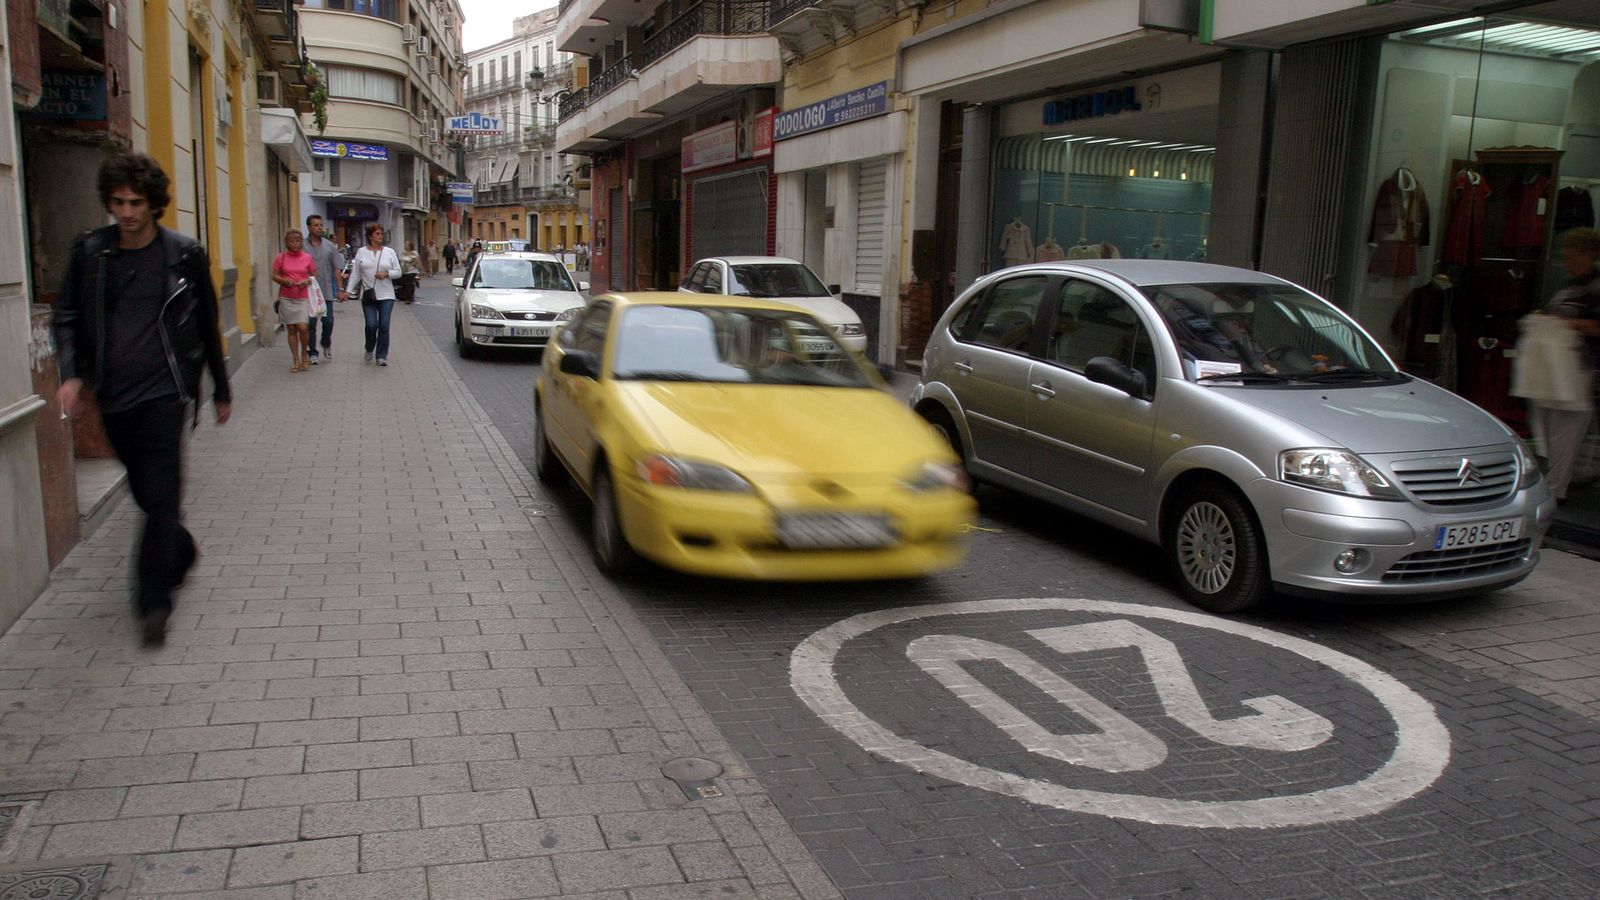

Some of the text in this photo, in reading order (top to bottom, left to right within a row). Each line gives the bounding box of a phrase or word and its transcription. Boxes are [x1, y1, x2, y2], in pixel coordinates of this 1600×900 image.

[42, 73, 97, 87] ARNET
[451, 112, 499, 129] MELDY
[774, 103, 826, 138] PODOLOGO
[1447, 520, 1516, 546] 5285 CPL
[906, 618, 1335, 773] 20
